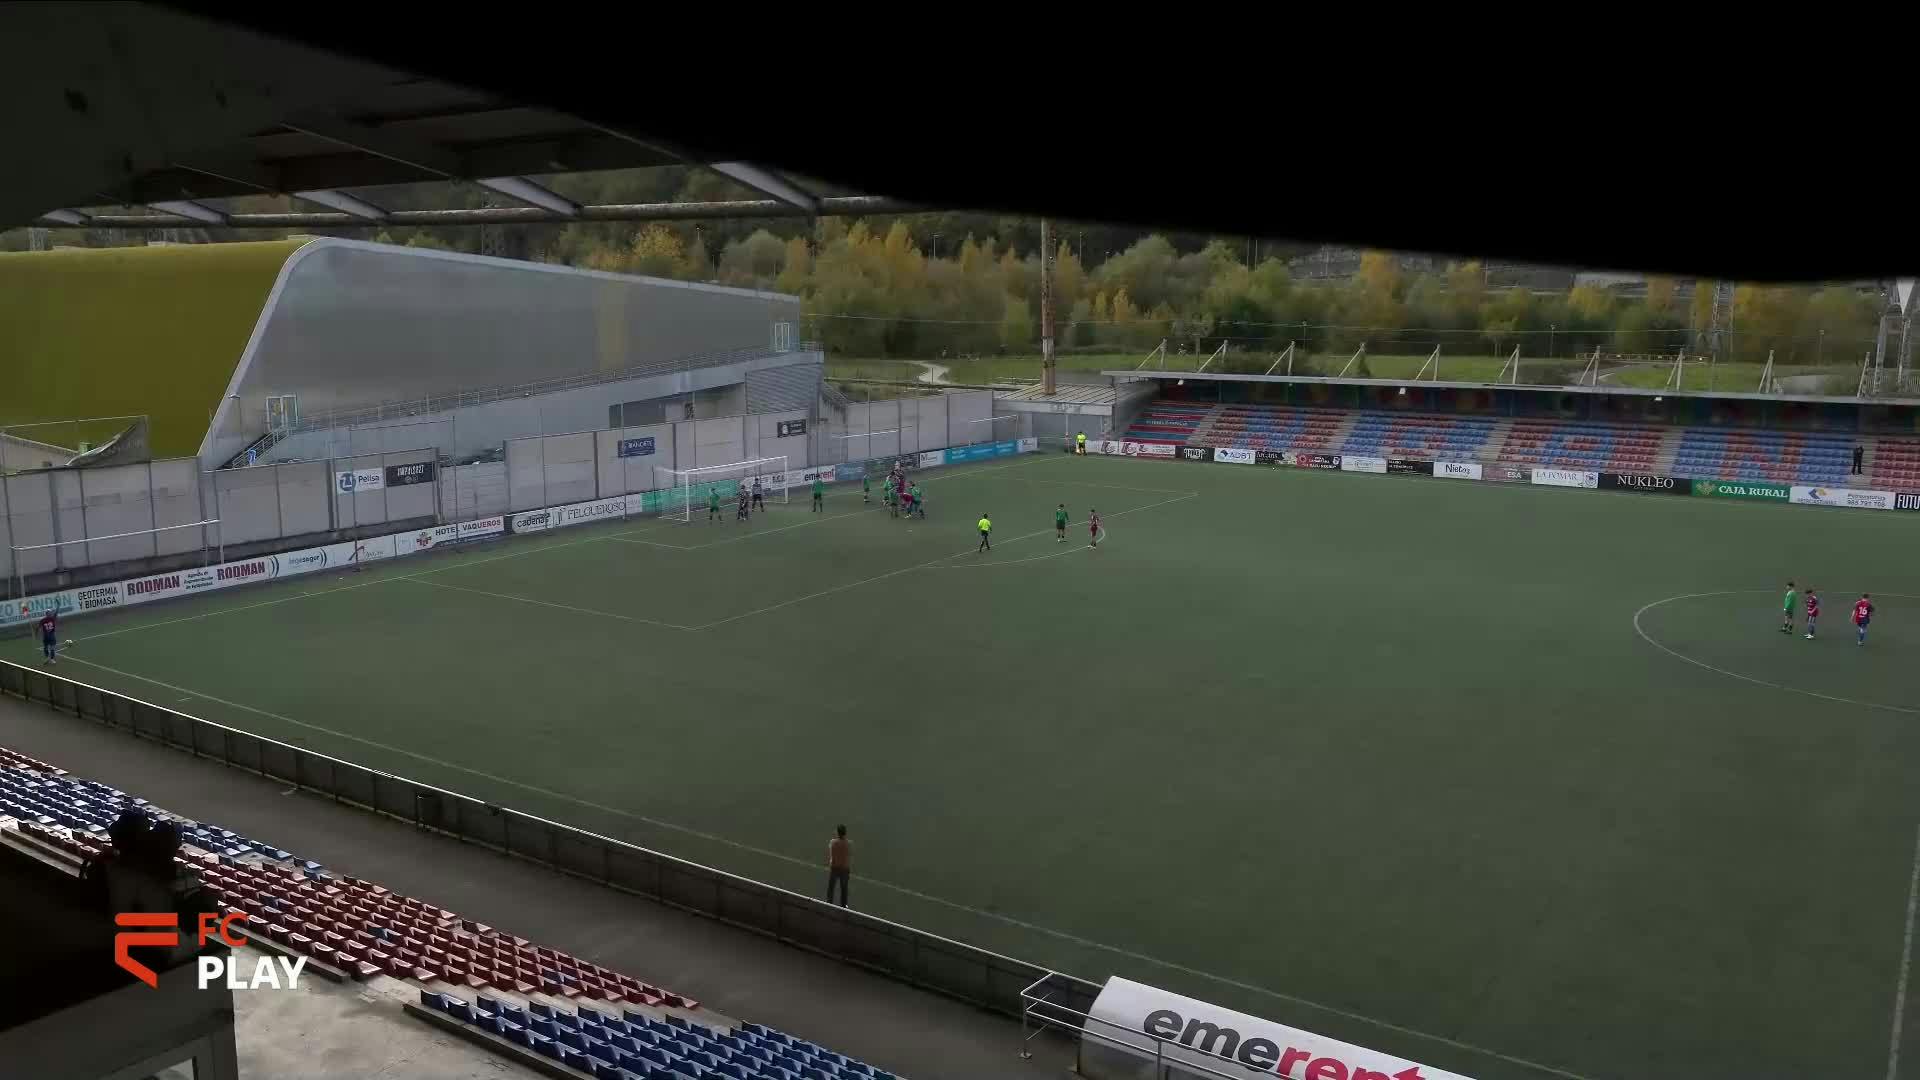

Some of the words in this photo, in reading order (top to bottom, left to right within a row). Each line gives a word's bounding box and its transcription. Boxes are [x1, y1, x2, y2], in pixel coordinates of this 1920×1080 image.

[1718, 485, 1746, 495] CAJA
[1749, 487, 1788, 498] RURAL
[462, 519, 501, 531] VAQUEROS
[127, 576, 180, 596] RODMAN
[217, 561, 265, 580] RODMAN
[78, 587, 119, 601] GEOTERMIA
[85, 596, 117, 609] BIOMASA
[1858, 606, 1868, 615] 16
